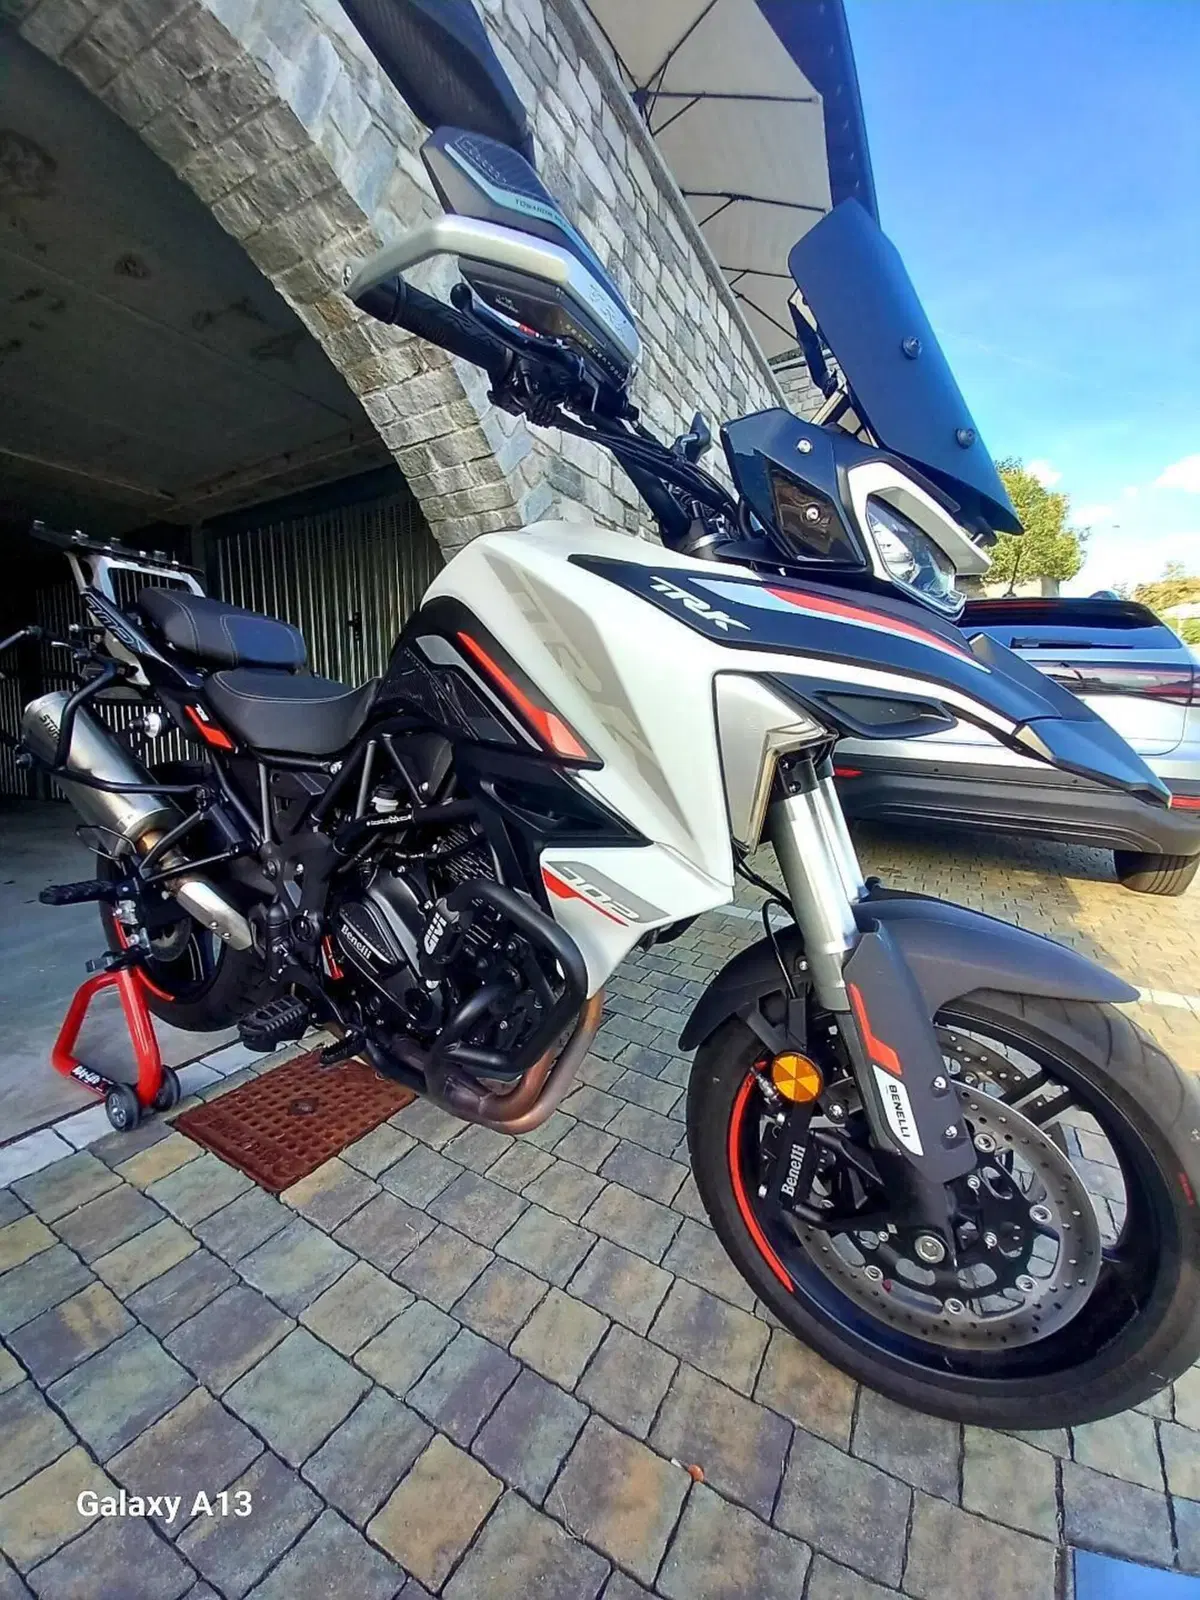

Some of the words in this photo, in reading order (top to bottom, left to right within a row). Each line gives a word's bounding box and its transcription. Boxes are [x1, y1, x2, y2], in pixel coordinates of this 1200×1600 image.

[649, 575, 752, 632] TRK
[559, 866, 641, 923] 702
[340, 923, 372, 960] Benelli
[423, 911, 448, 955] GIVI
[888, 1084, 911, 1138] BENELLI
[780, 1143, 806, 1198] Benelli
